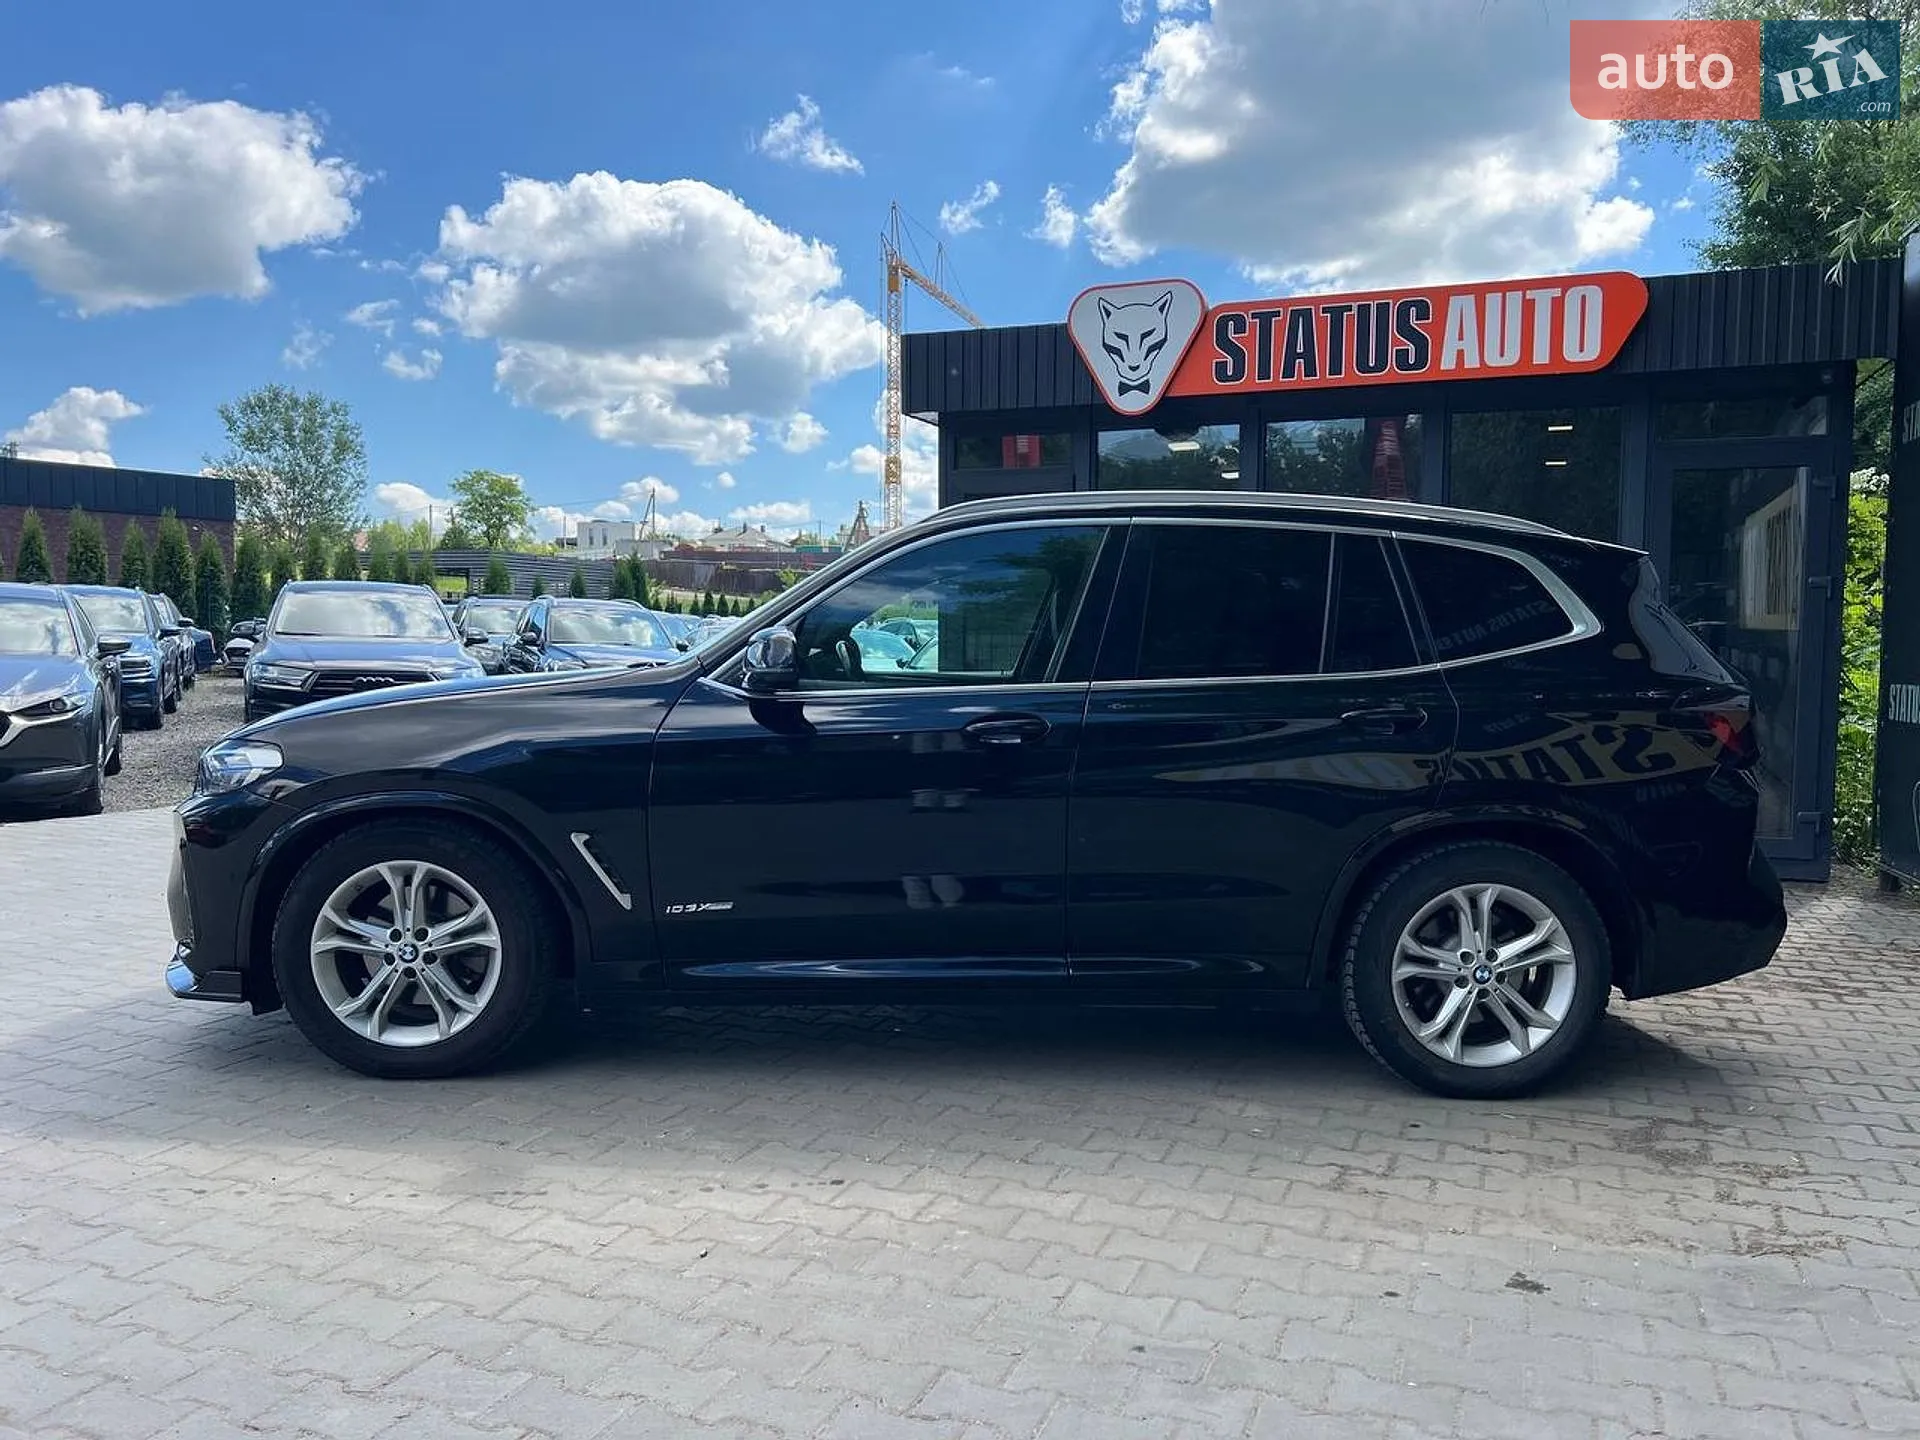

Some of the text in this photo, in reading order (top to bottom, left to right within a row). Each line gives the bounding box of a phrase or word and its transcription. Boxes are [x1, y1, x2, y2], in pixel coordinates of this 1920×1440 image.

[1212, 284, 1603, 385] STATUS AUTO
[1889, 683, 1920, 724] STATU
